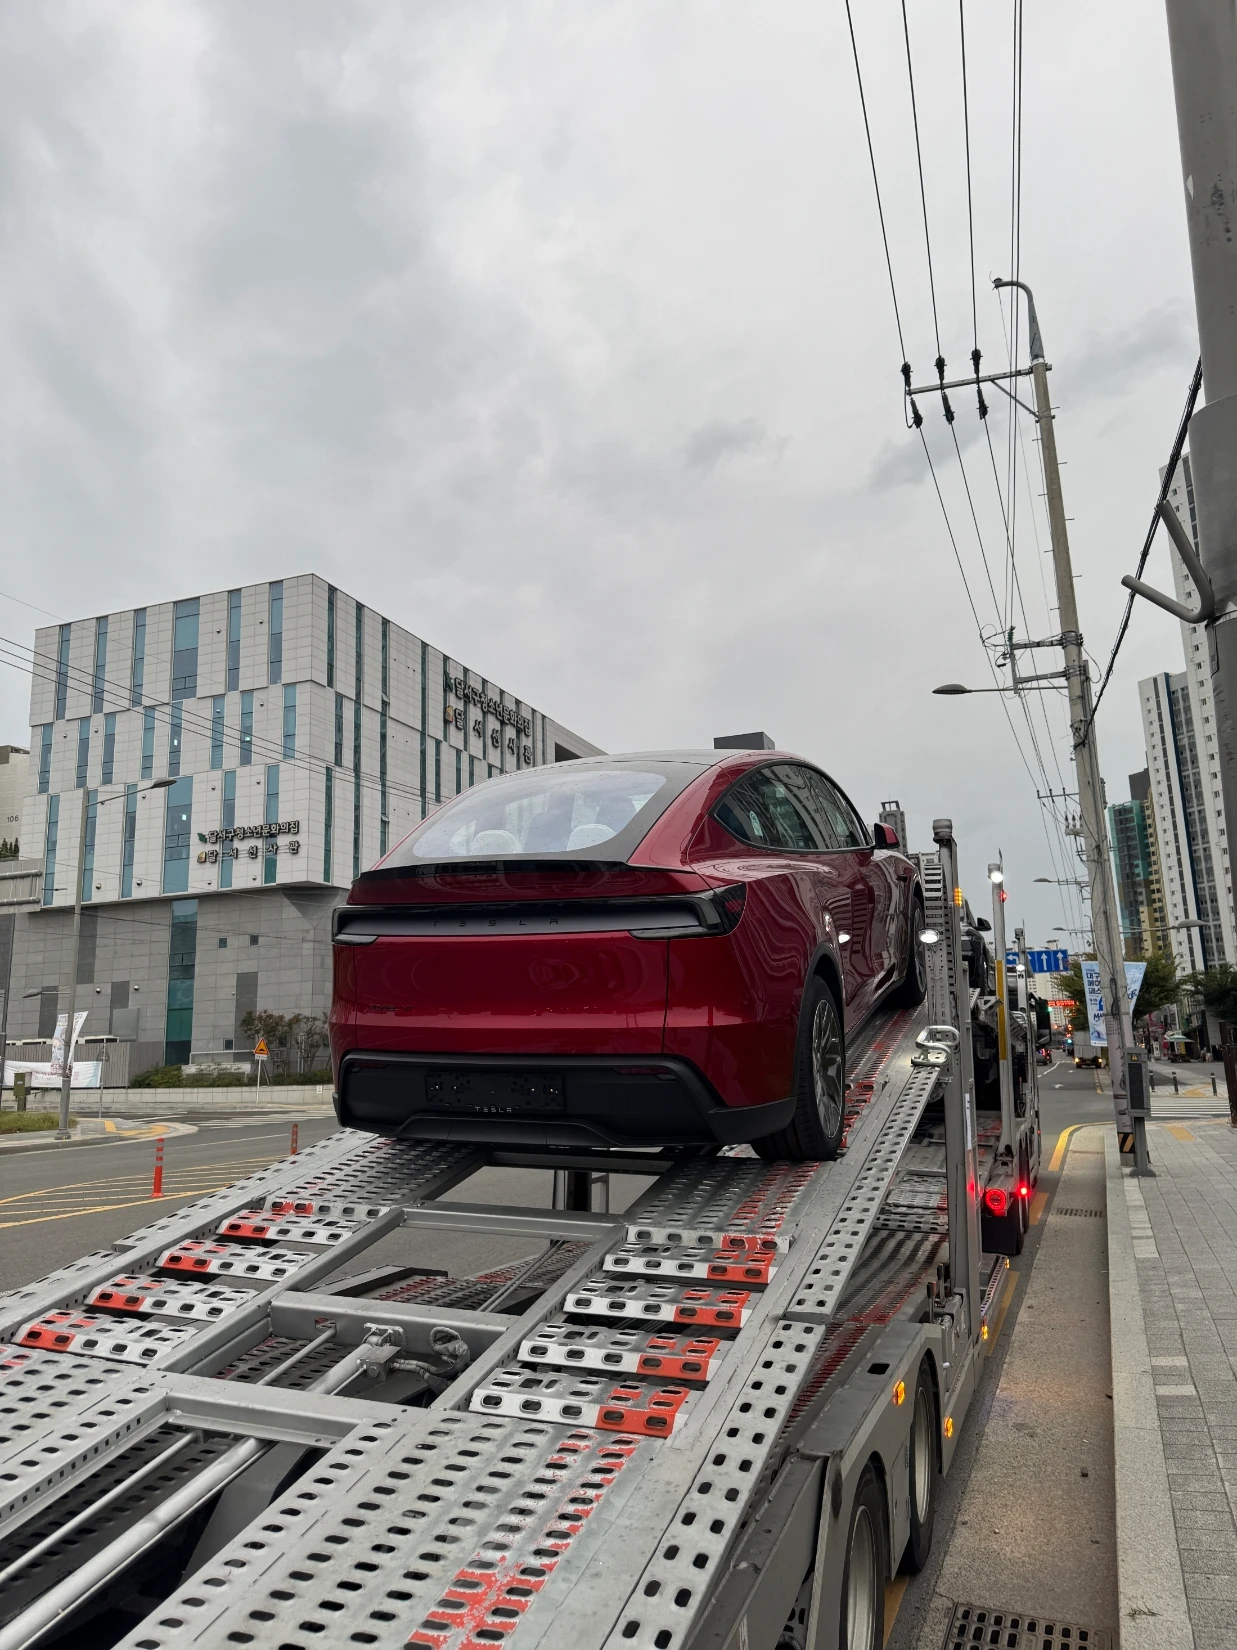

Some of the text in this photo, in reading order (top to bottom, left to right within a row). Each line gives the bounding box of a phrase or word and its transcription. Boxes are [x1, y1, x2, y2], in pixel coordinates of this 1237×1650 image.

[453, 677, 532, 736] 달서구청소년문화의집
[207, 820, 300, 843] 달서구청소년문화의집
[433, 918, 559, 927] TESLA
[475, 1105, 512, 1114] TESLA
